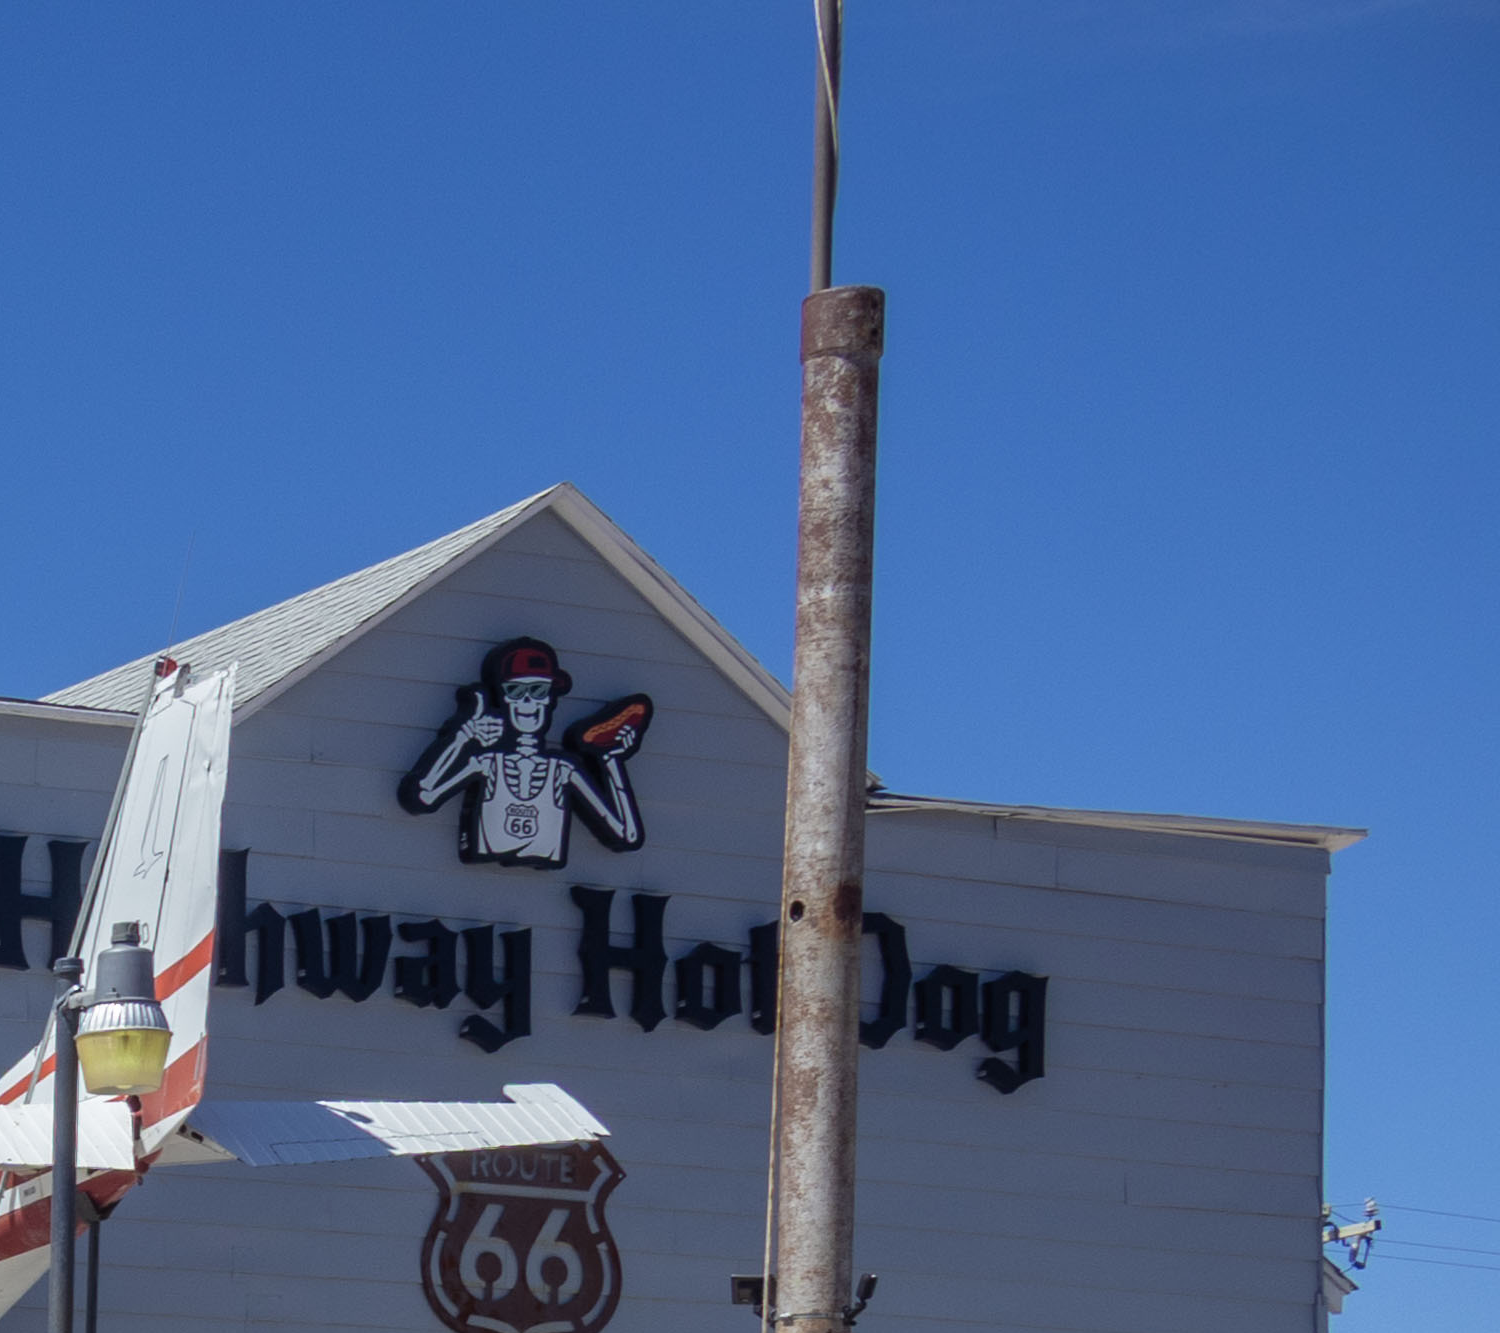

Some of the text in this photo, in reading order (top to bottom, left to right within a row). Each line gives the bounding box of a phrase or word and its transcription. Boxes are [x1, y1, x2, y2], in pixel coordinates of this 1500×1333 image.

[511, 818, 532, 834] 66
[472, 1150, 574, 1183] ROUTE
[459, 1203, 584, 1305] 66
